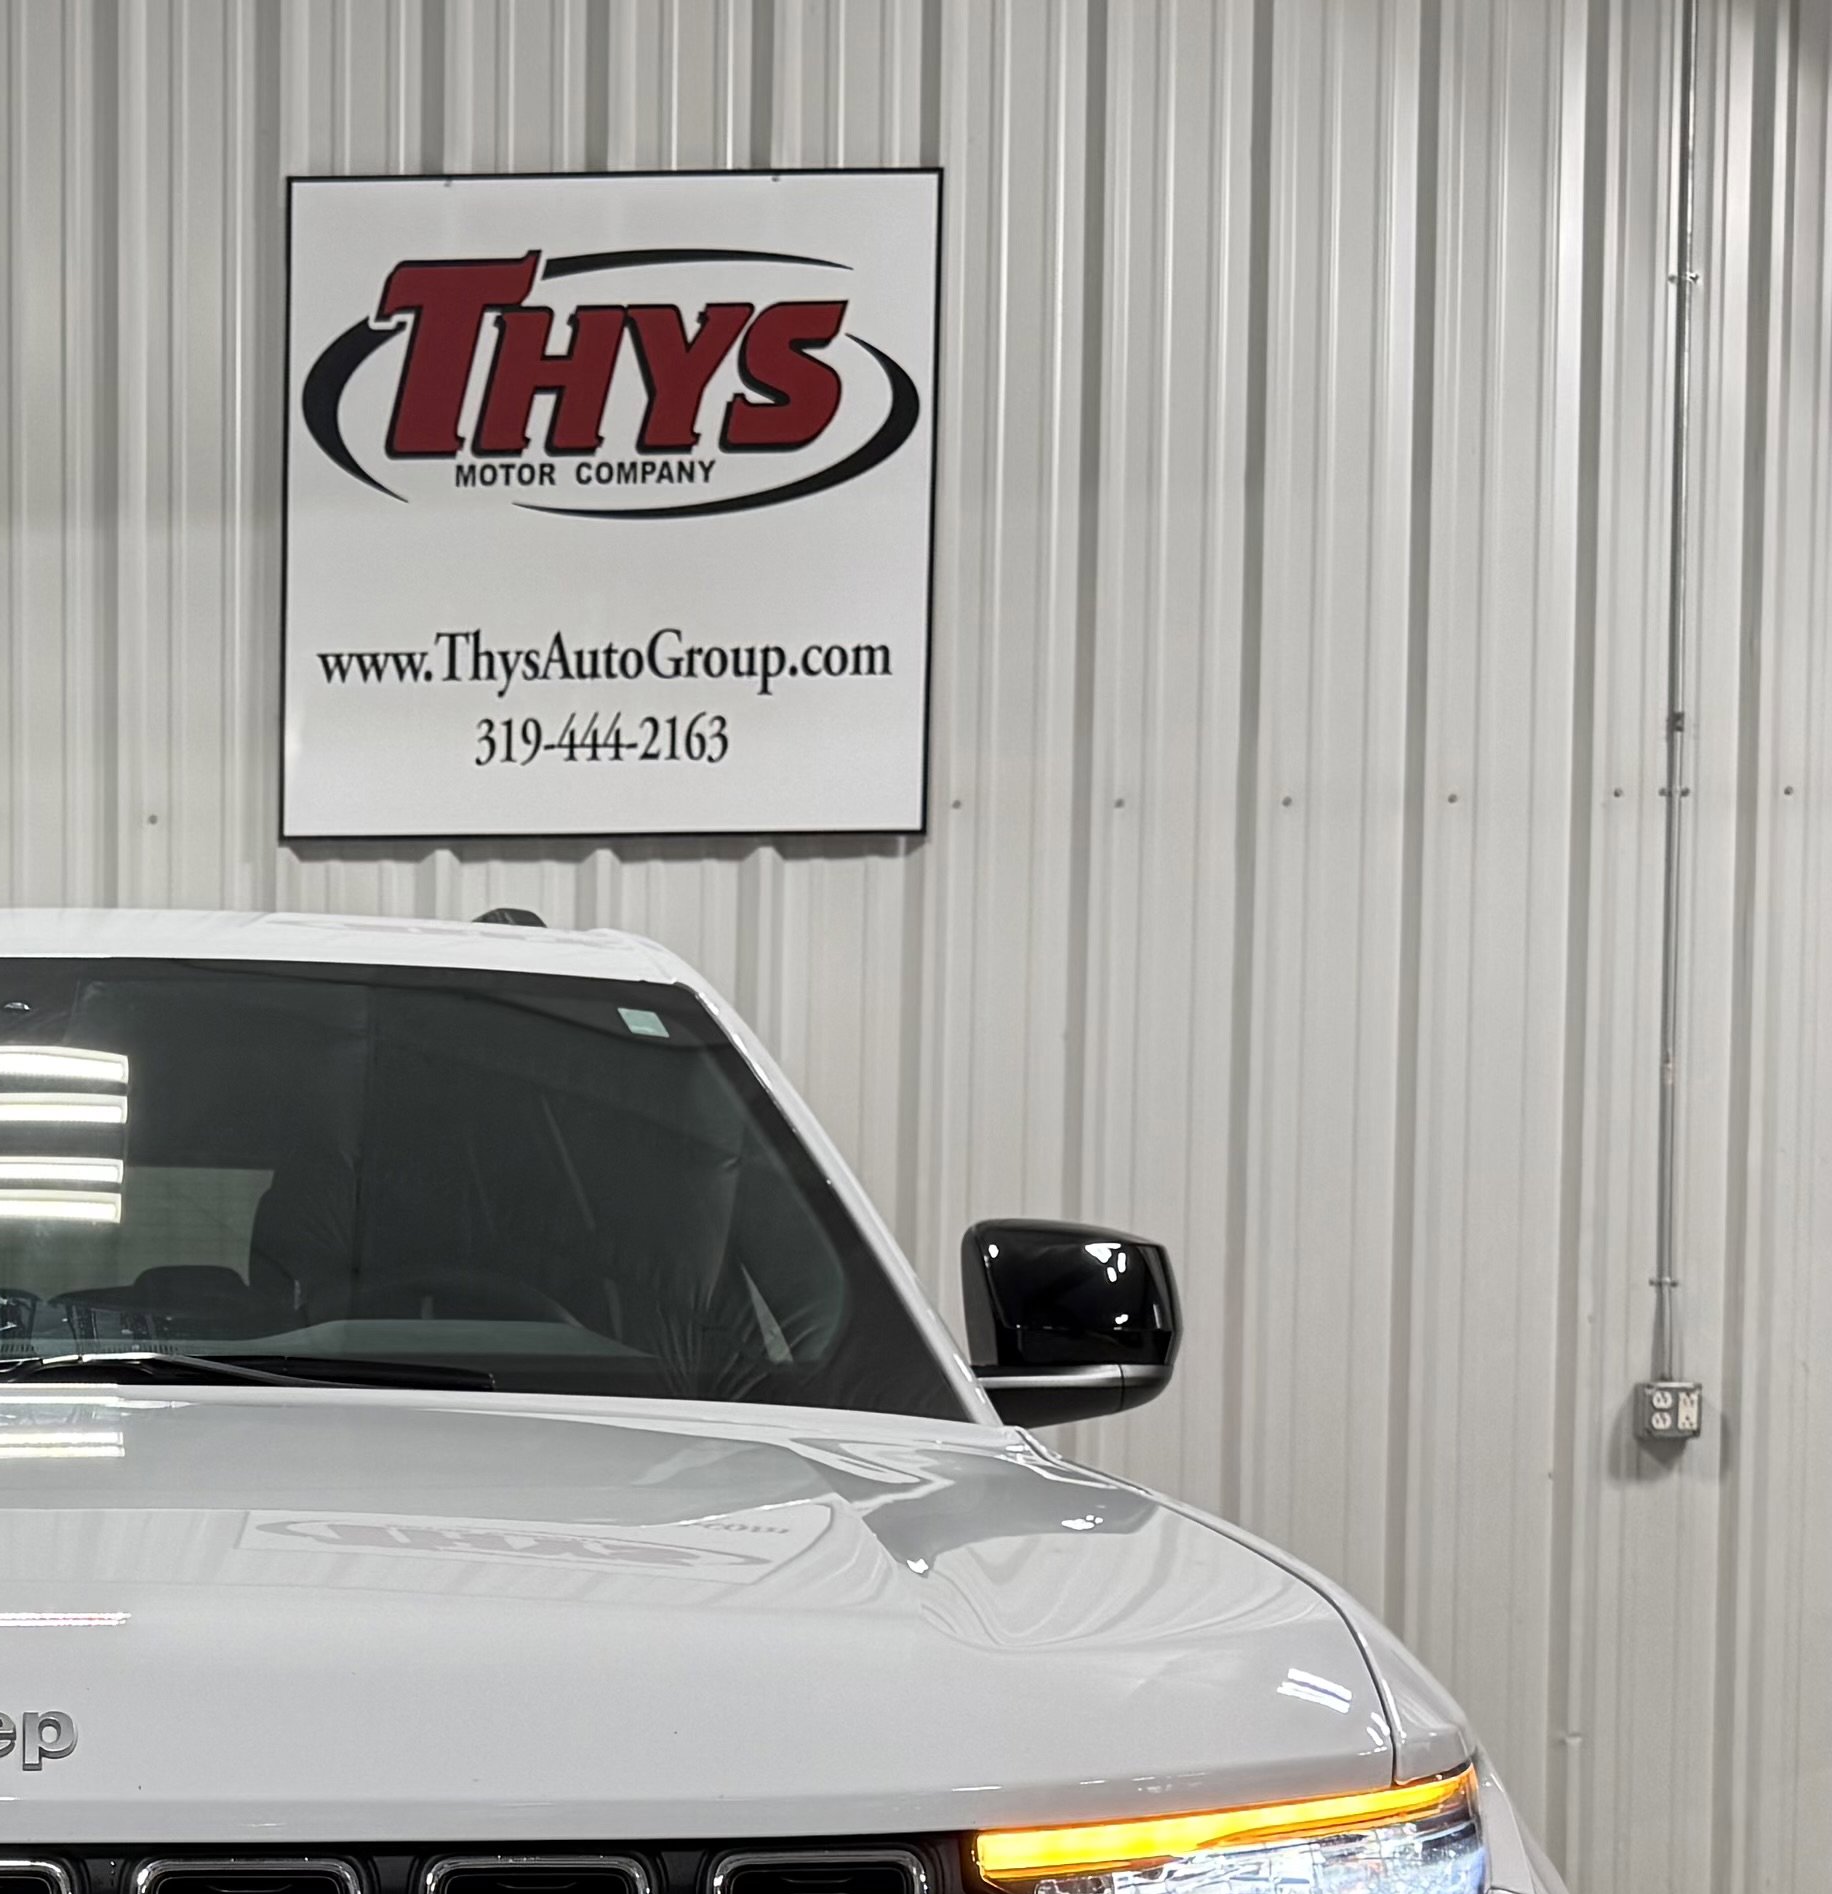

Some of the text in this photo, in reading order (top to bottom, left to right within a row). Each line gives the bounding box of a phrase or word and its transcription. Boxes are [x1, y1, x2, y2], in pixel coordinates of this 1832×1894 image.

[374, 249, 849, 458] THYS
[454, 460, 717, 489] MOTOR COMPANY
[317, 628, 893, 697] www.ThysAutoGroup.com
[474, 711, 730, 766] 319-444-2163
